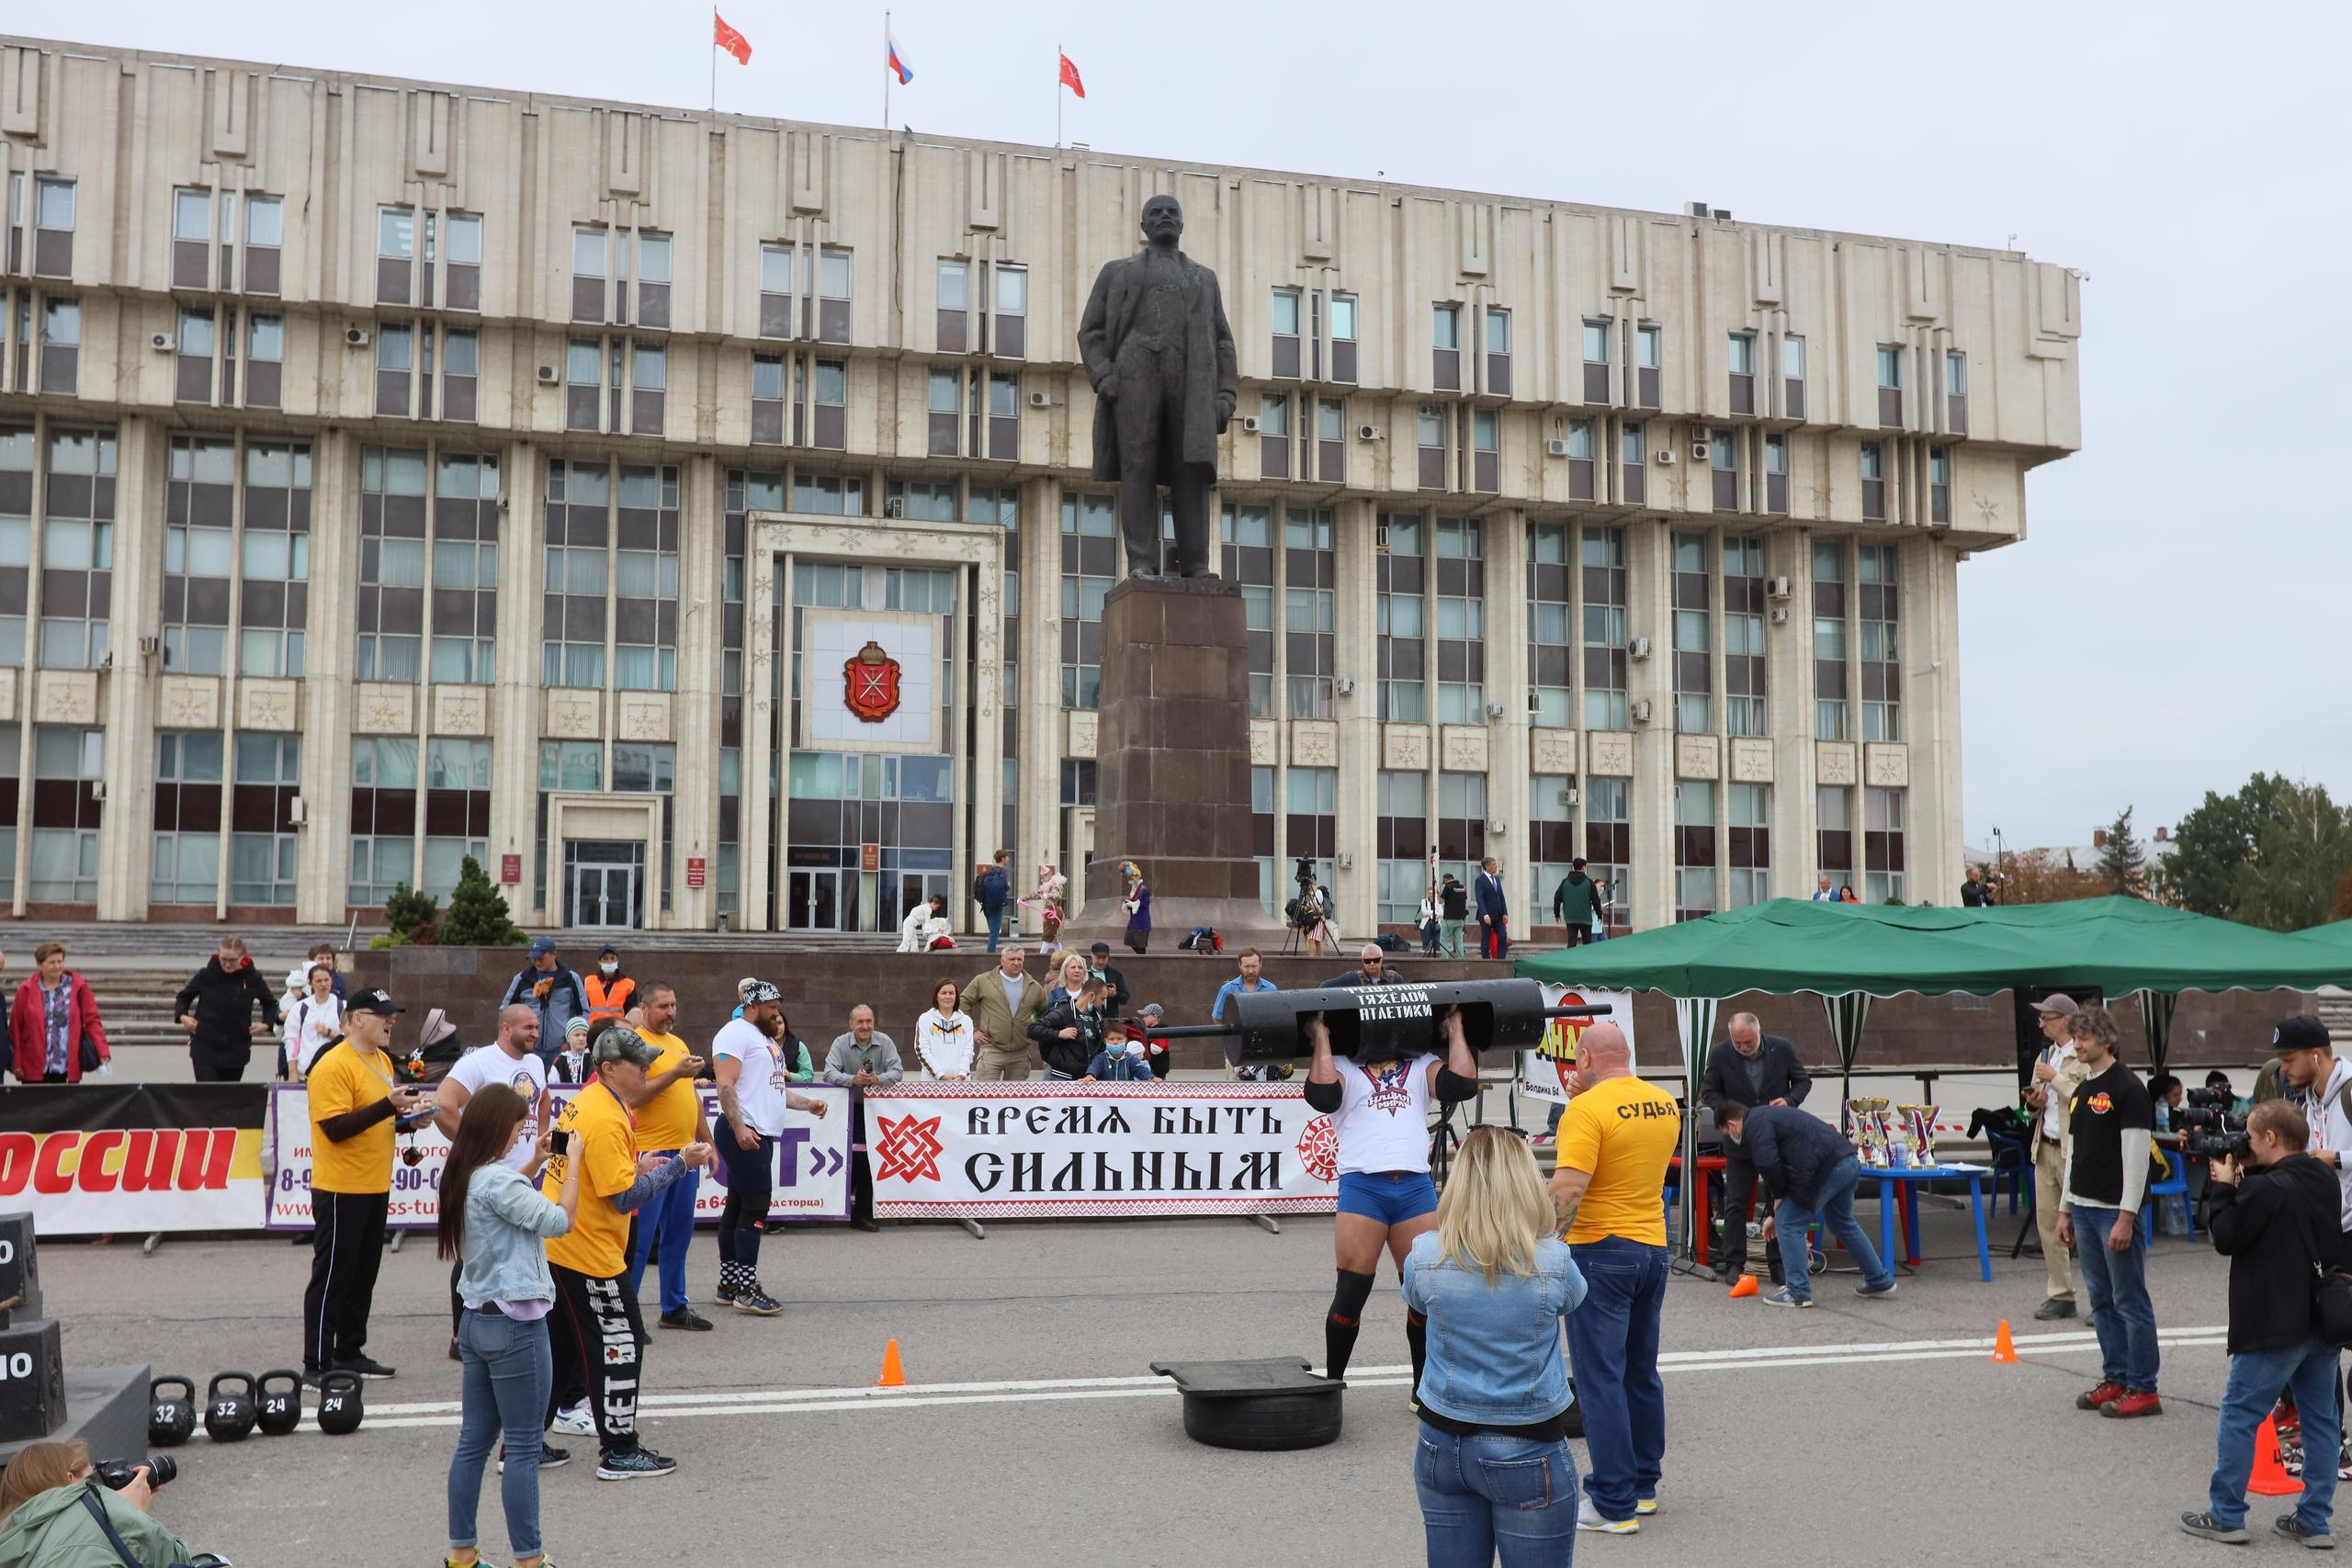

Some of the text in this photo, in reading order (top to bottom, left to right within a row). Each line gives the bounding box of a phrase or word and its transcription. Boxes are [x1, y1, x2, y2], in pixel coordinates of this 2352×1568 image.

[1360, 1004, 1432, 1021] АТЛЕТИКИ
[1525, 1081, 1559, 1097] Болдина 94
[1617, 1101, 1677, 1120] СУДЬЯ
[1151, 1106, 1283, 1134] БЫТЬ
[965, 1151, 1283, 1193] СИЛЬНЫМ
[788, 1198, 824, 1209] торца)
[217, 1402, 237, 1416] 32
[266, 1398, 286, 1414] 24
[324, 1397, 343, 1412] 24
[604, 1375, 637, 1435] GET
[155, 1404, 175, 1423] 32
